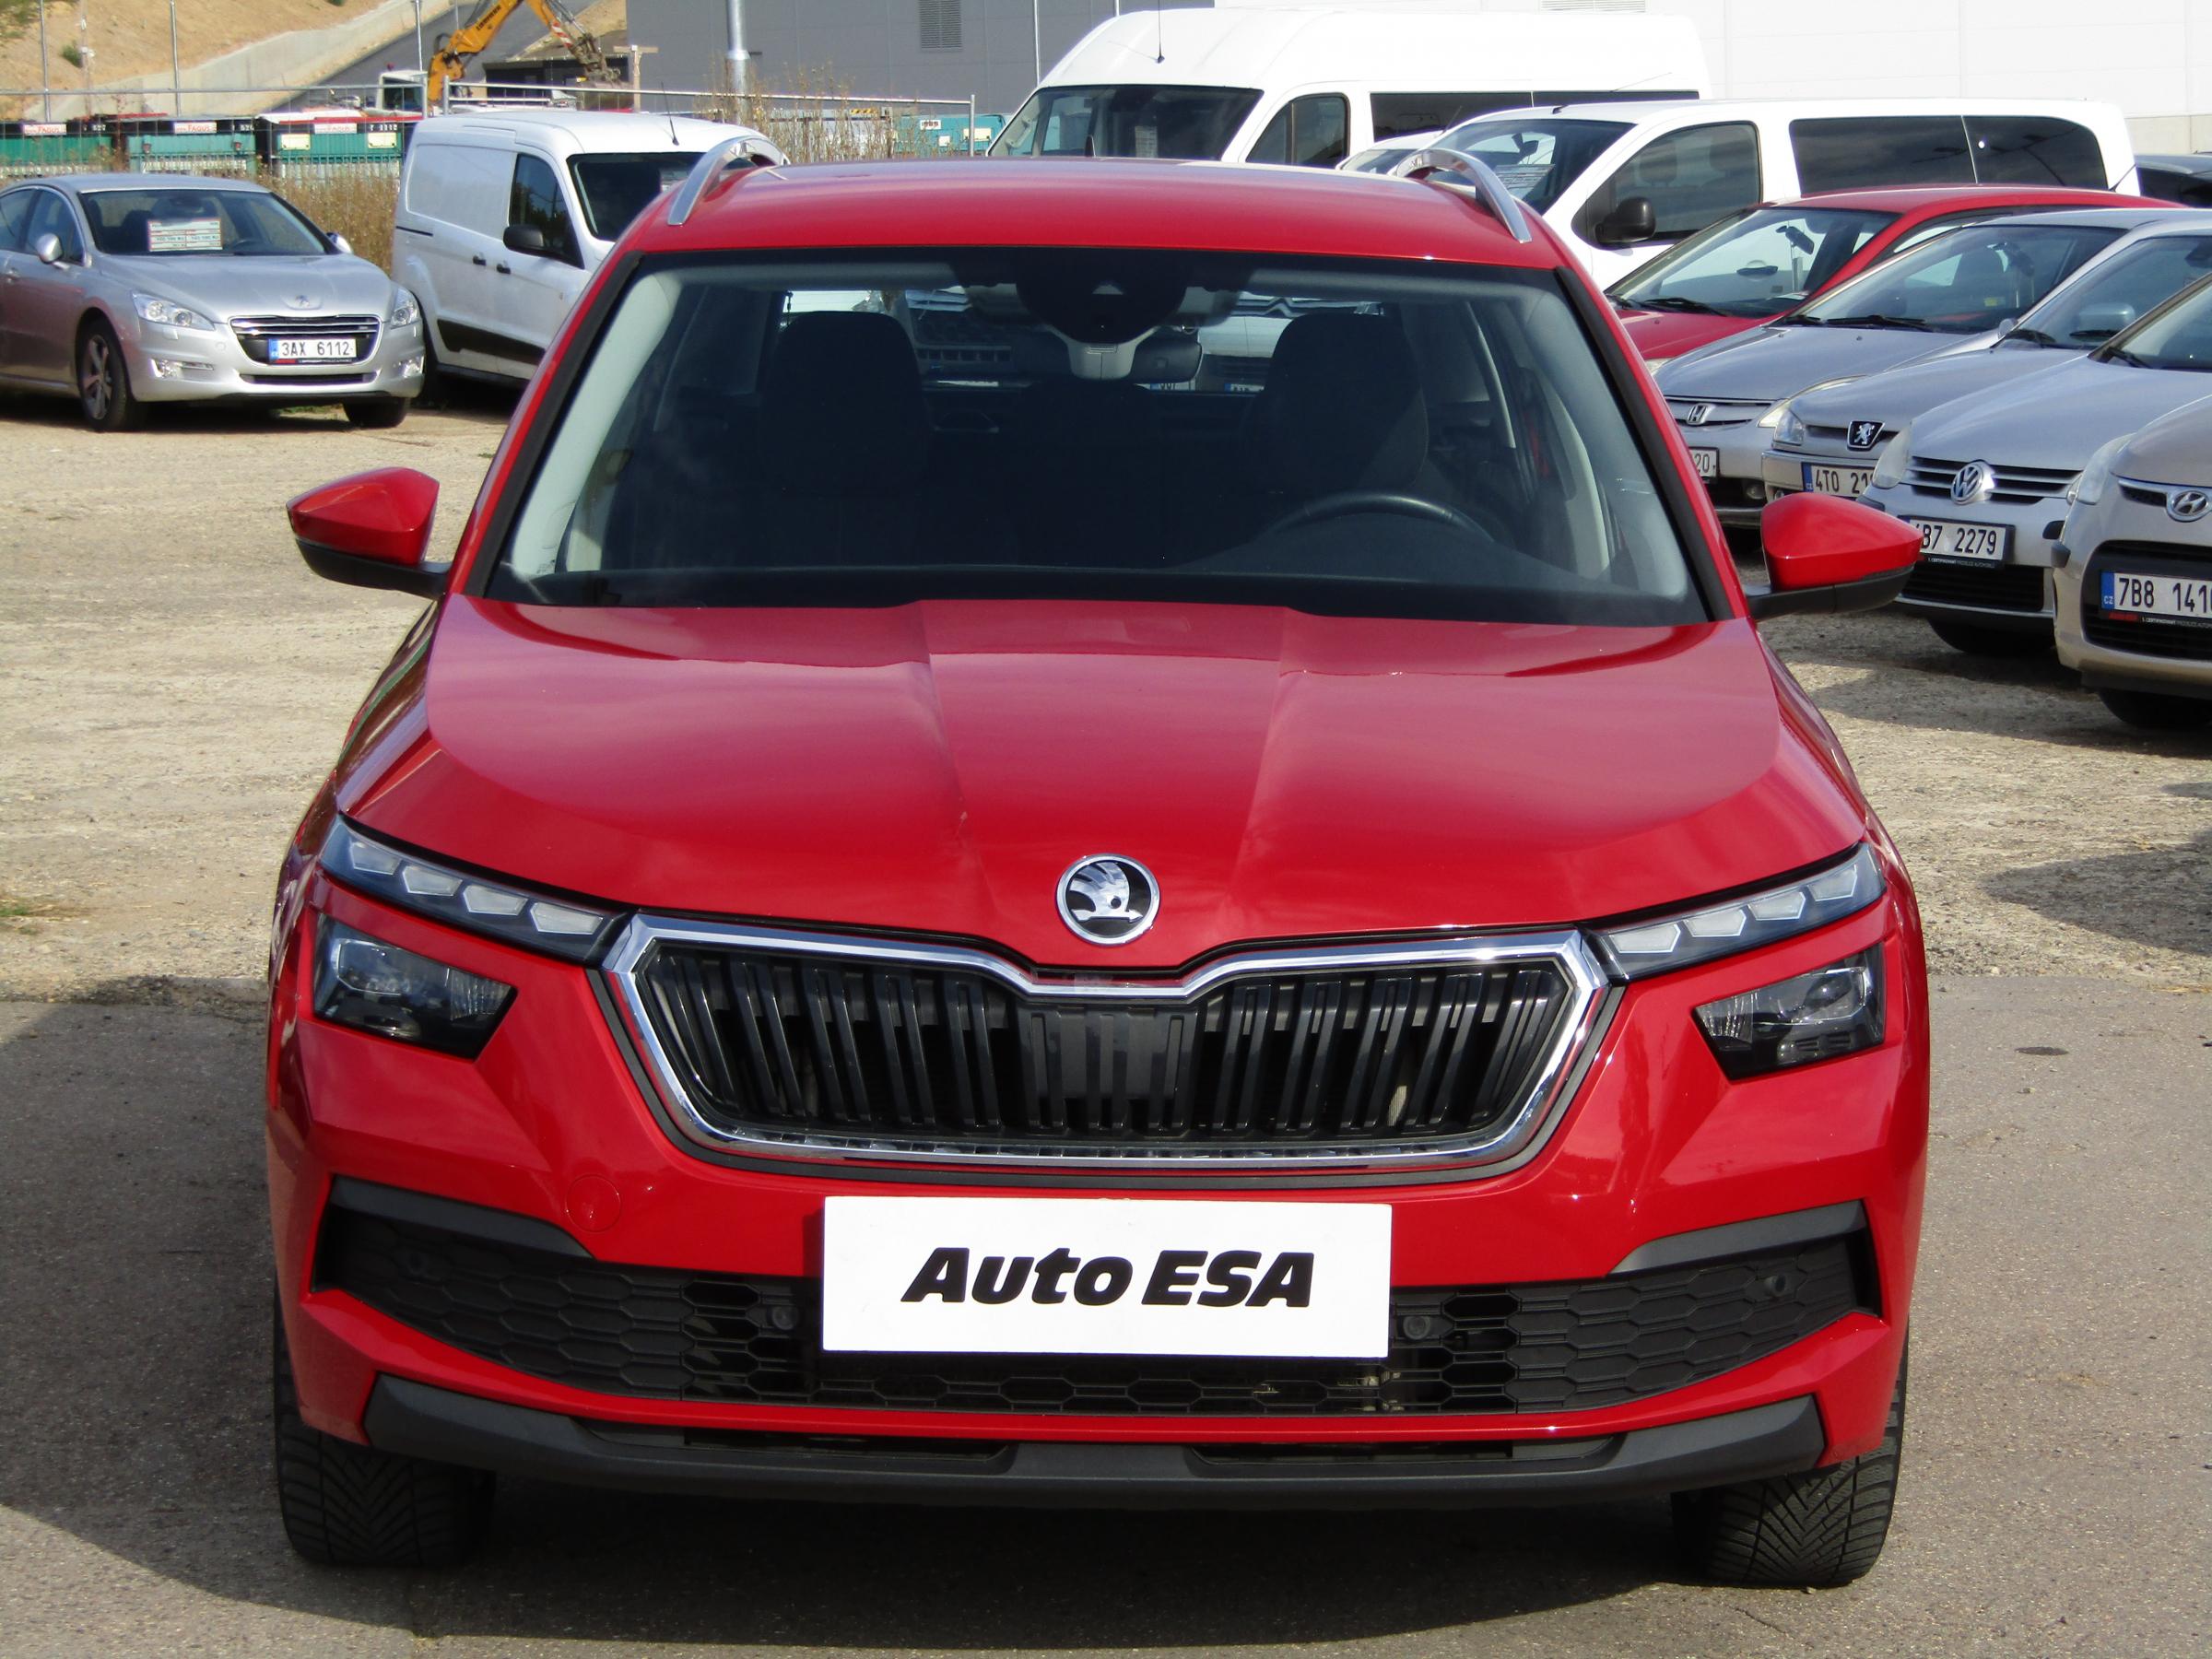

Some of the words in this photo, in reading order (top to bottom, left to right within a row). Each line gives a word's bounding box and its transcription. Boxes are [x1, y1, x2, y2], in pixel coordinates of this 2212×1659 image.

[282, 342, 306, 356] 3AX
[317, 341, 349, 356] 6112
[1916, 523, 1943, 550] B7
[1954, 526, 1997, 555] 2279
[2103, 595, 2113, 605] CZ
[2119, 577, 2155, 608] 7B8
[2172, 582, 2212, 614] 141
[900, 1247, 1134, 1305] Auto
[1141, 1249, 1315, 1308] ESA
